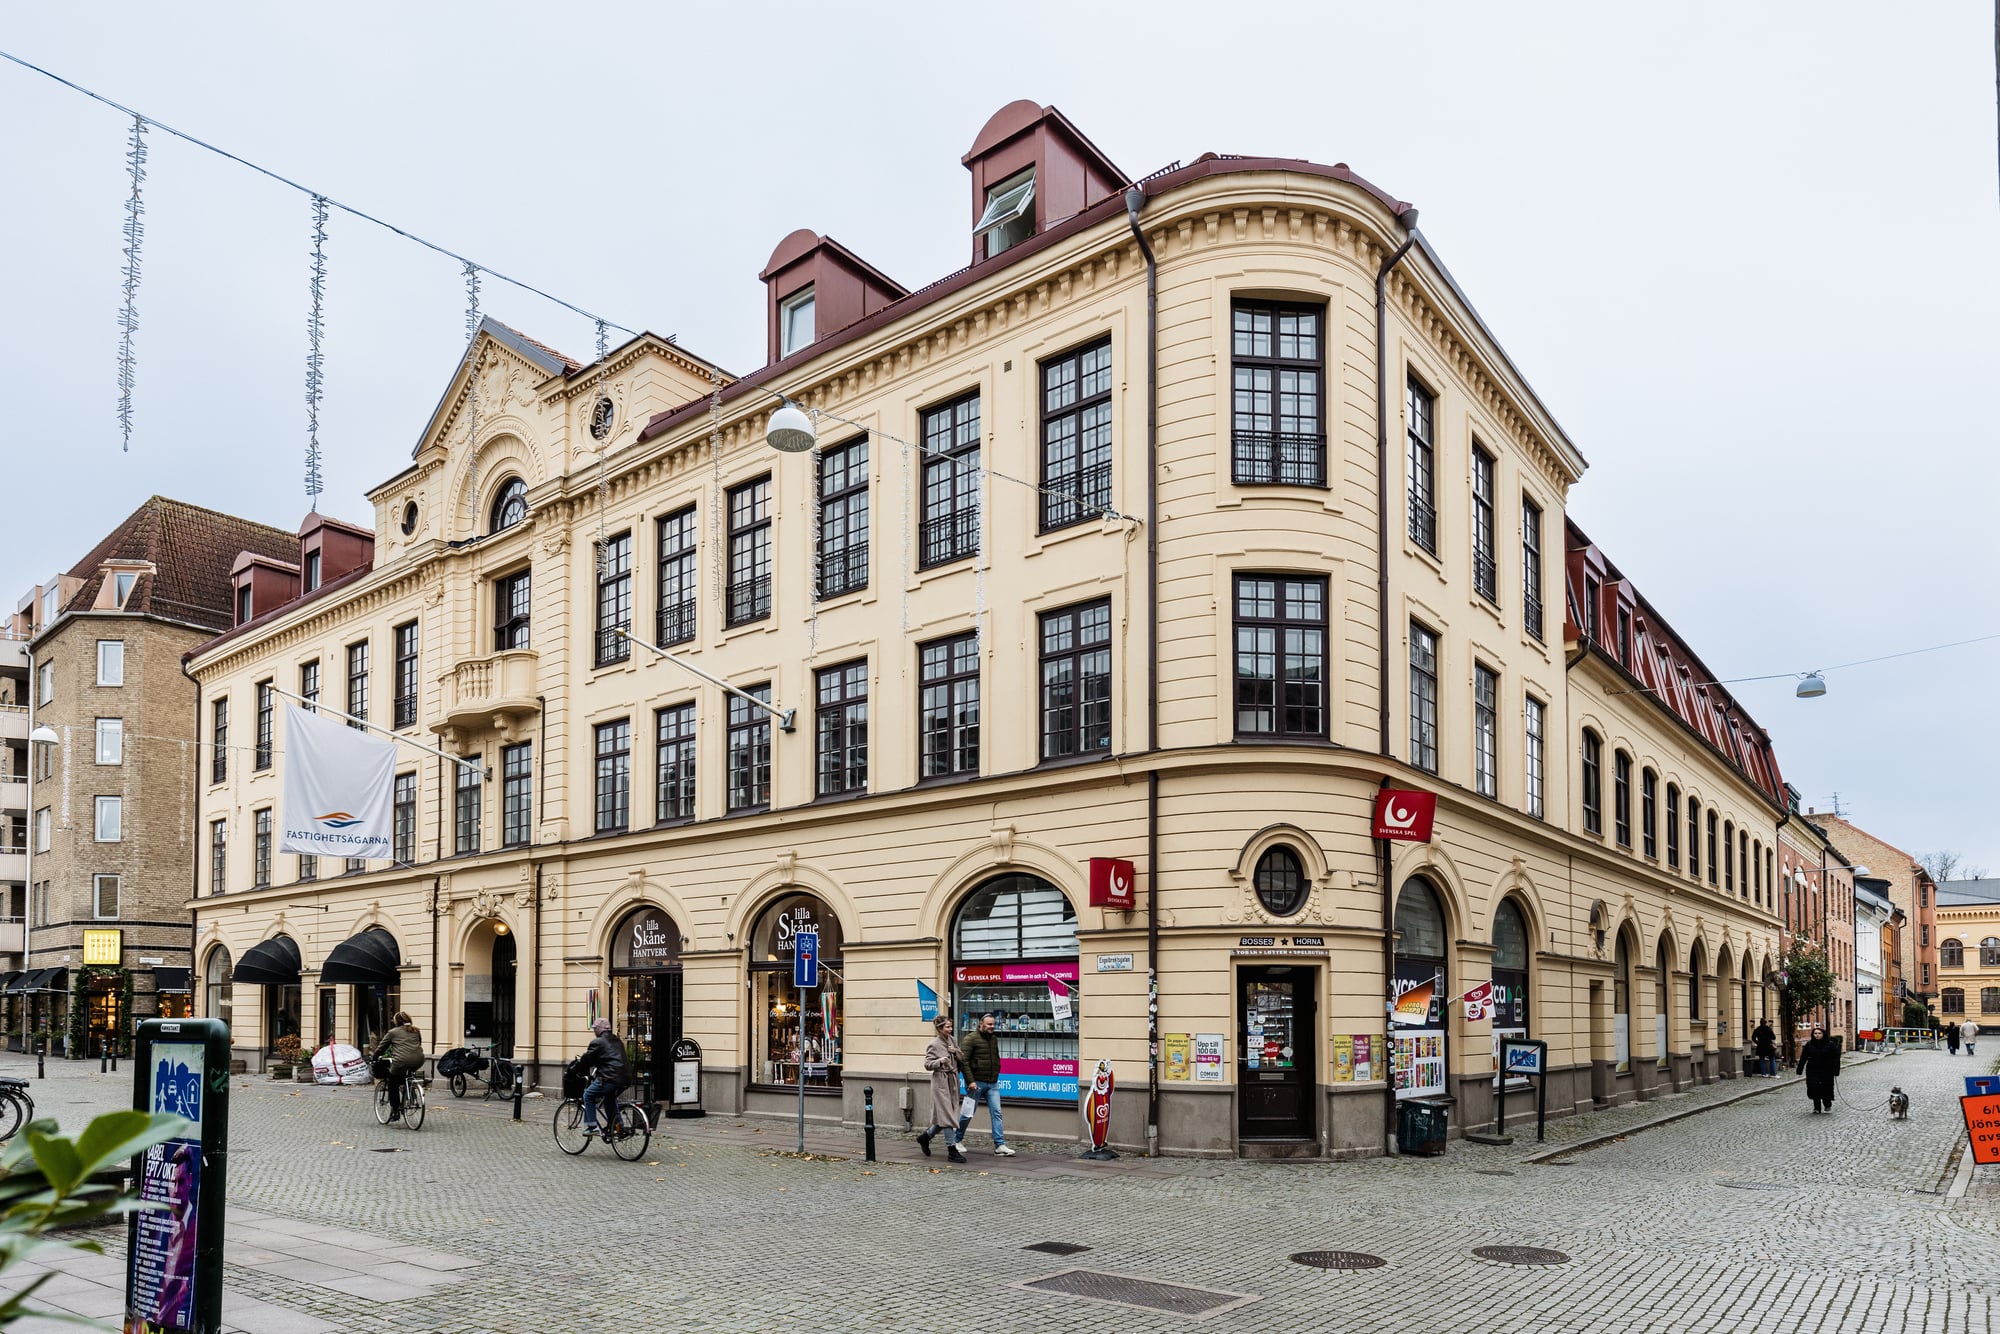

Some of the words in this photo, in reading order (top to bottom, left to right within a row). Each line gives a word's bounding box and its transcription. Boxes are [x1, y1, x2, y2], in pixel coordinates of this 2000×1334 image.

[287, 830, 389, 844] FASTIGHETSÄGARNA
[794, 907, 810, 920] lilla
[646, 919, 659, 931] lilla
[778, 912, 819, 940] Skåne
[633, 924, 666, 949] Skåne
[632, 947, 668, 958] HANTVERK
[1017, 1080, 1048, 1091] SOUVENIRS
[1048, 1082, 1061, 1092] AND
[1061, 1083, 1077, 1093] GIFTS
